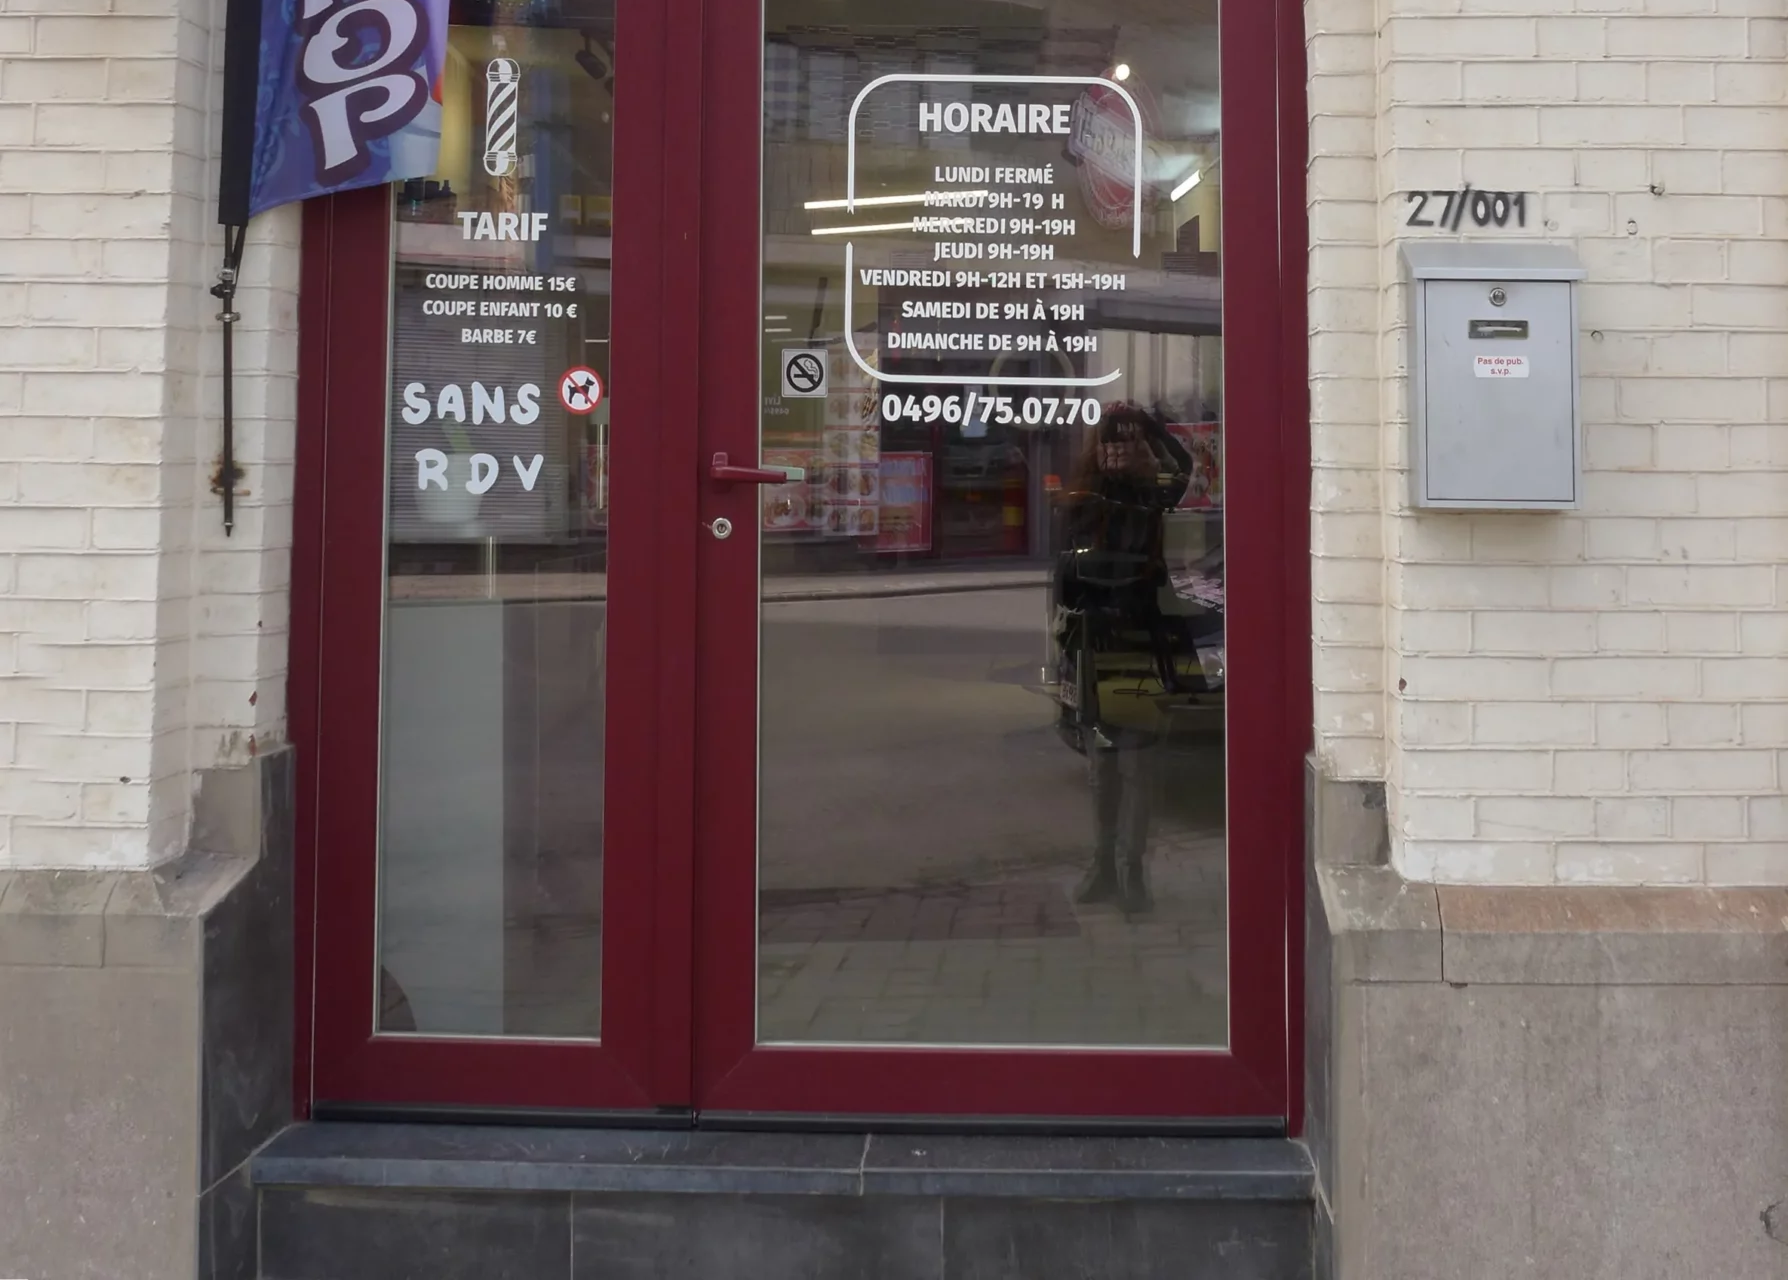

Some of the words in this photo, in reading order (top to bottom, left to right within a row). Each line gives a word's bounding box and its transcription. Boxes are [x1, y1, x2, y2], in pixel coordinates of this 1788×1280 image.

[918, 102, 1072, 135] HORAIRE
[934, 166, 990, 184] LUNDI
[994, 163, 1054, 185] FERMÉ
[923, 190, 986, 208] MARDI
[1406, 182, 1526, 232] 27/001
[457, 211, 549, 242] TARIF
[912, 216, 1006, 235] MERCREDI
[1009, 218, 1076, 236] 9H-19H
[933, 242, 983, 262] JEUDI
[987, 243, 1054, 261] 9H-19H
[425, 273, 479, 291] COUPE
[482, 275, 544, 292] HOMME
[547, 276, 577, 292] 15€
[859, 268, 951, 288] VENDREDI
[955, 271, 1021, 289] 9H-12H
[1026, 272, 1048, 290] ET
[1051, 273, 1126, 291] 15H-19H
[422, 299, 476, 317] COUPE
[479, 301, 541, 318] ENFANT
[544, 303, 563, 319] 10
[901, 301, 971, 319] SAMEDI
[975, 302, 1000, 320] DE
[1003, 303, 1029, 320] 9H
[1032, 298, 1046, 321] À
[1050, 304, 1085, 321] 19H
[461, 328, 514, 345] BARBE
[516, 329, 538, 346] 7€
[887, 331, 984, 350] DIMANCHE
[988, 333, 1012, 351] DE
[1016, 334, 1041, 352] 9H
[1045, 329, 1059, 352] À
[1062, 335, 1098, 353] 19H
[1477, 357, 1493, 365] Pas
[1494, 357, 1505, 365] de
[1506, 357, 1524, 367] pub.
[401, 381, 541, 425] SANS
[882, 392, 1102, 427] 0496/75.07.70
